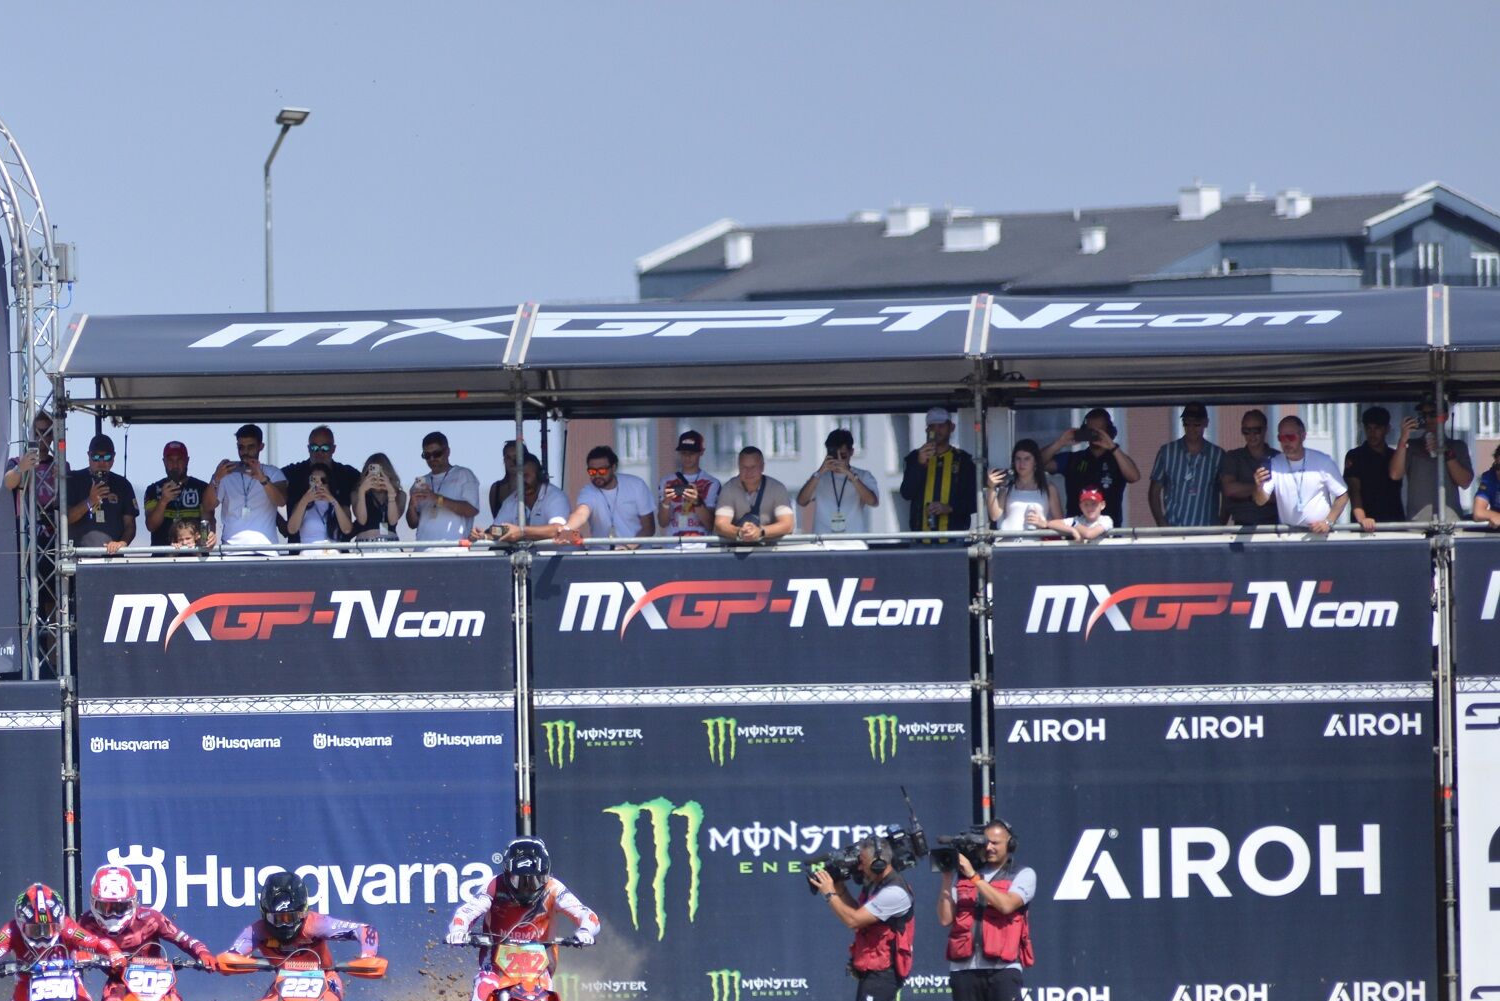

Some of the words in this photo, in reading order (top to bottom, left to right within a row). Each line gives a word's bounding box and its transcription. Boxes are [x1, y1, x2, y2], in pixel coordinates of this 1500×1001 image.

[558, 577, 944, 643] MXGP-TV.com
[1025, 580, 1400, 644] MXGP-TV.com
[103, 589, 486, 654] MXGP-TV.com
[576, 727, 644, 741] MONSTER
[737, 724, 804, 739] MONSTER
[899, 721, 966, 736] MONSTER
[1008, 719, 1106, 743] AIROH
[1165, 715, 1264, 740] AIROH
[1324, 713, 1423, 737] AIROH
[104, 738, 169, 752] Husqvarna
[216, 736, 281, 750] Husqvarna
[327, 734, 393, 749] Husqvarna
[438, 732, 503, 747] Husqvarna
[1053, 823, 1382, 901] AIROH
[32, 978, 75, 1001] 350
[129, 971, 173, 993] 202
[281, 978, 324, 999] 223
[581, 980, 648, 993] MONSTER
[742, 977, 809, 990] MONSTER
[904, 975, 951, 988] MONST
